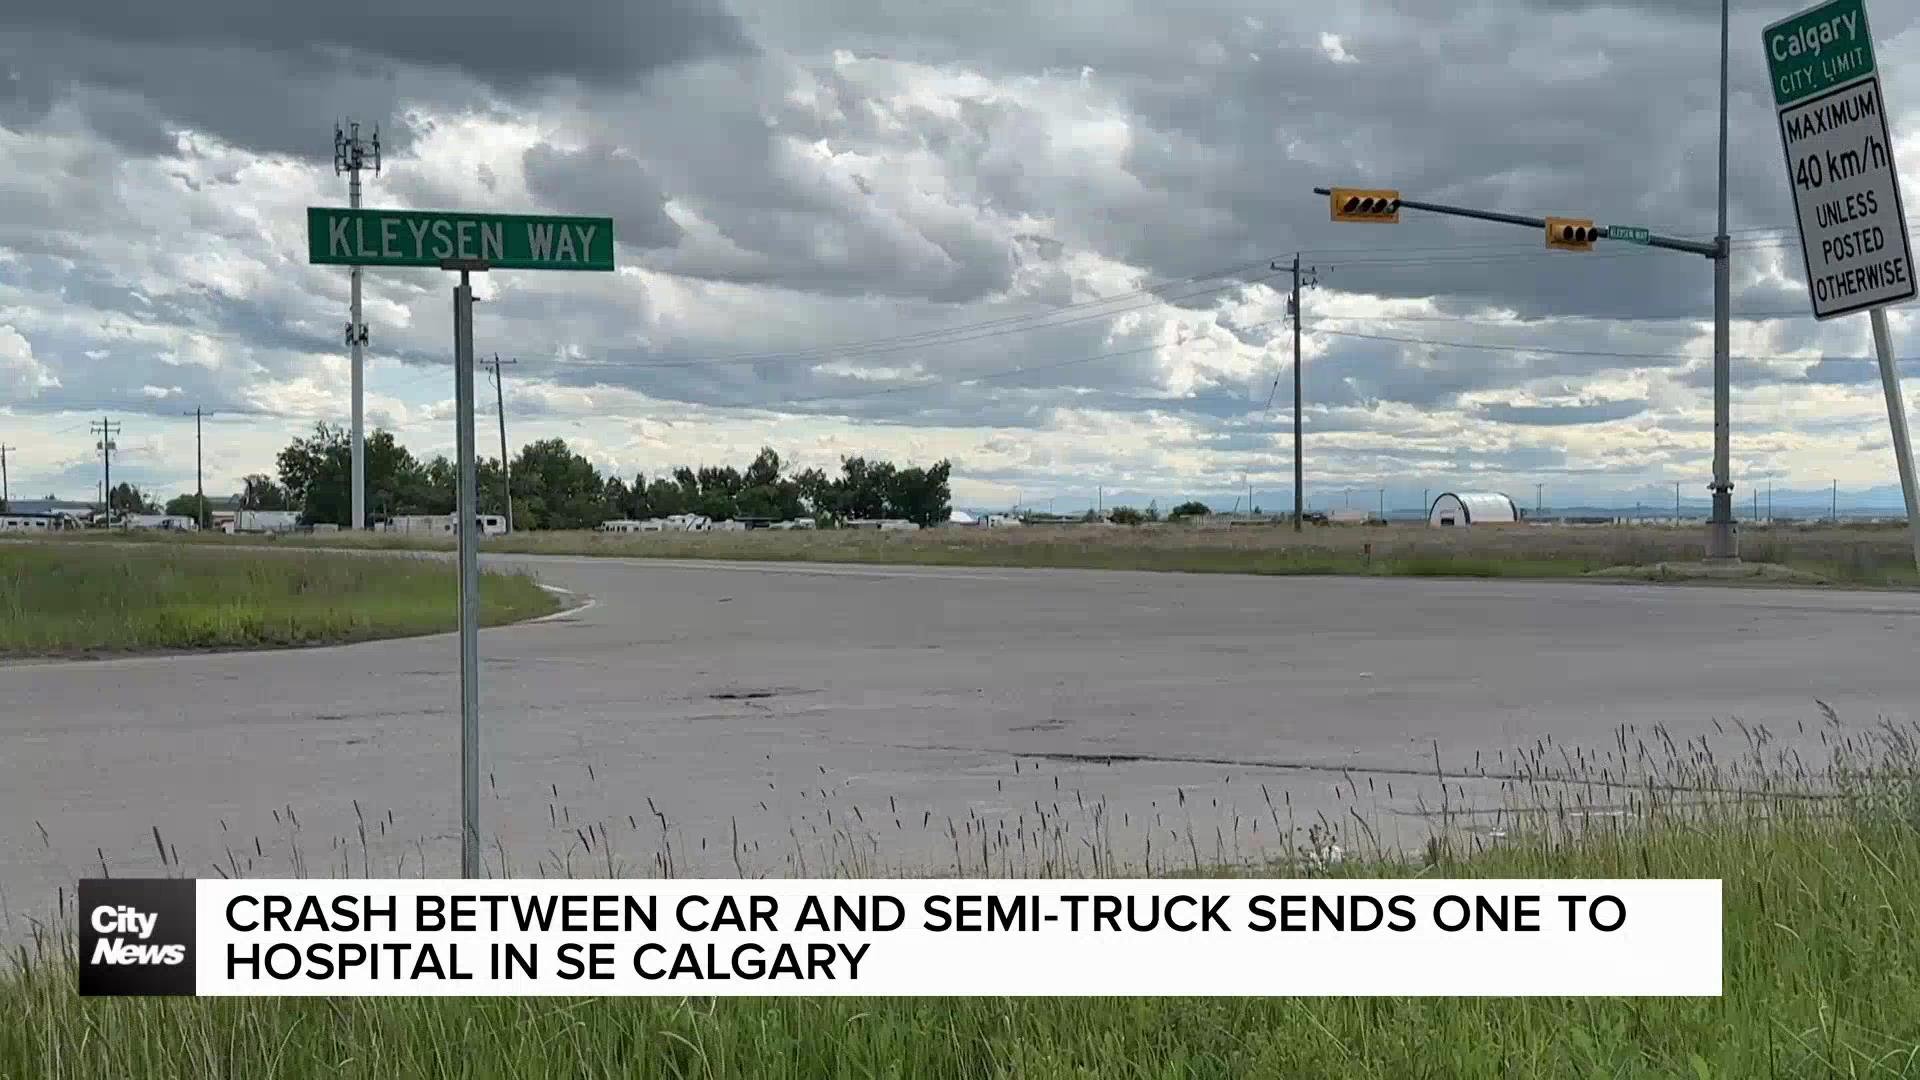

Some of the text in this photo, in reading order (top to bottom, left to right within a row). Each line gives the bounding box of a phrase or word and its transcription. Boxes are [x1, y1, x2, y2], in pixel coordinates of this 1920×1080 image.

[1772, 10, 1857, 61] Calgary
[1780, 47, 1863, 94] CITY LIMIT
[1787, 91, 1875, 143] MAXIMUM
[1797, 135, 1886, 191] 40 km/h
[1816, 190, 1878, 228] UNLESS
[328, 216, 597, 262] KLEYSEN WAY
[1822, 226, 1884, 264] POSTED
[1816, 258, 1906, 302] OTHERWISE
